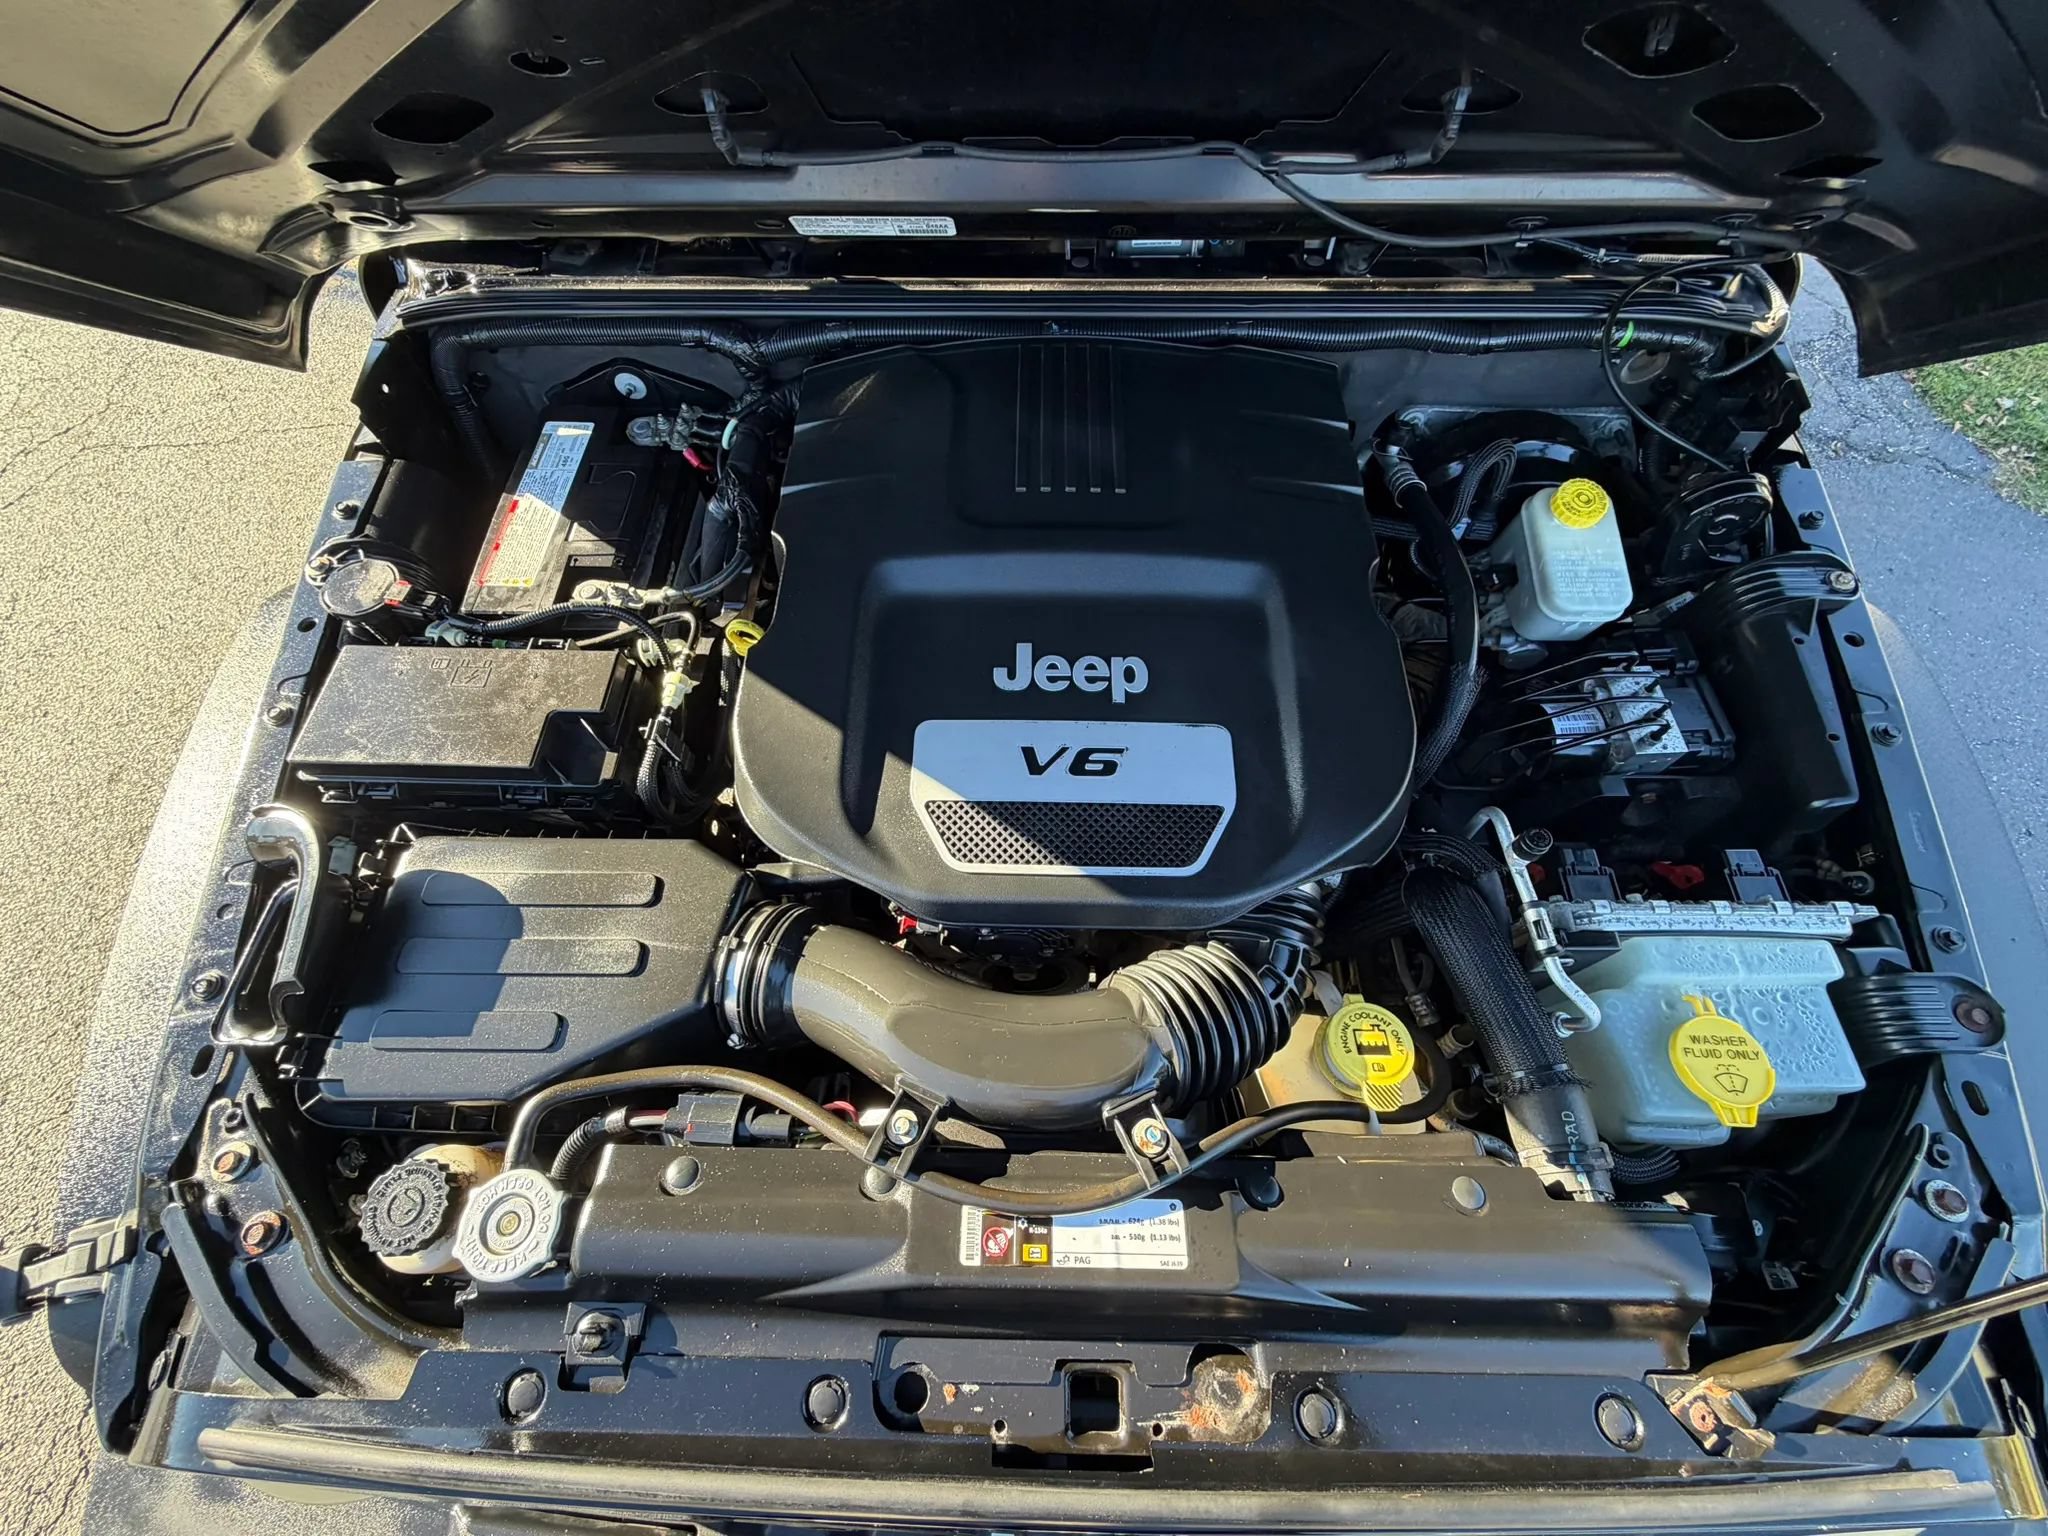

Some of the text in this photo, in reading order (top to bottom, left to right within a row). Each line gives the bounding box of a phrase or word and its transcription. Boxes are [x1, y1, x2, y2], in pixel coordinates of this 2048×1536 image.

[993, 643, 1149, 704] Jeep
[1020, 746, 1128, 777] V6
[1340, 1011, 1405, 1056] ENGINE COOLANT ONLY
[1689, 1035, 1748, 1047] WASHER
[1682, 1047, 1761, 1061] FLUID ONLY
[1561, 1111, 1579, 1144] RAD
[501, 1177, 534, 1191] OPEN
[490, 1252, 527, 1273] KEEP
[1074, 1256, 1091, 1265] PAG
